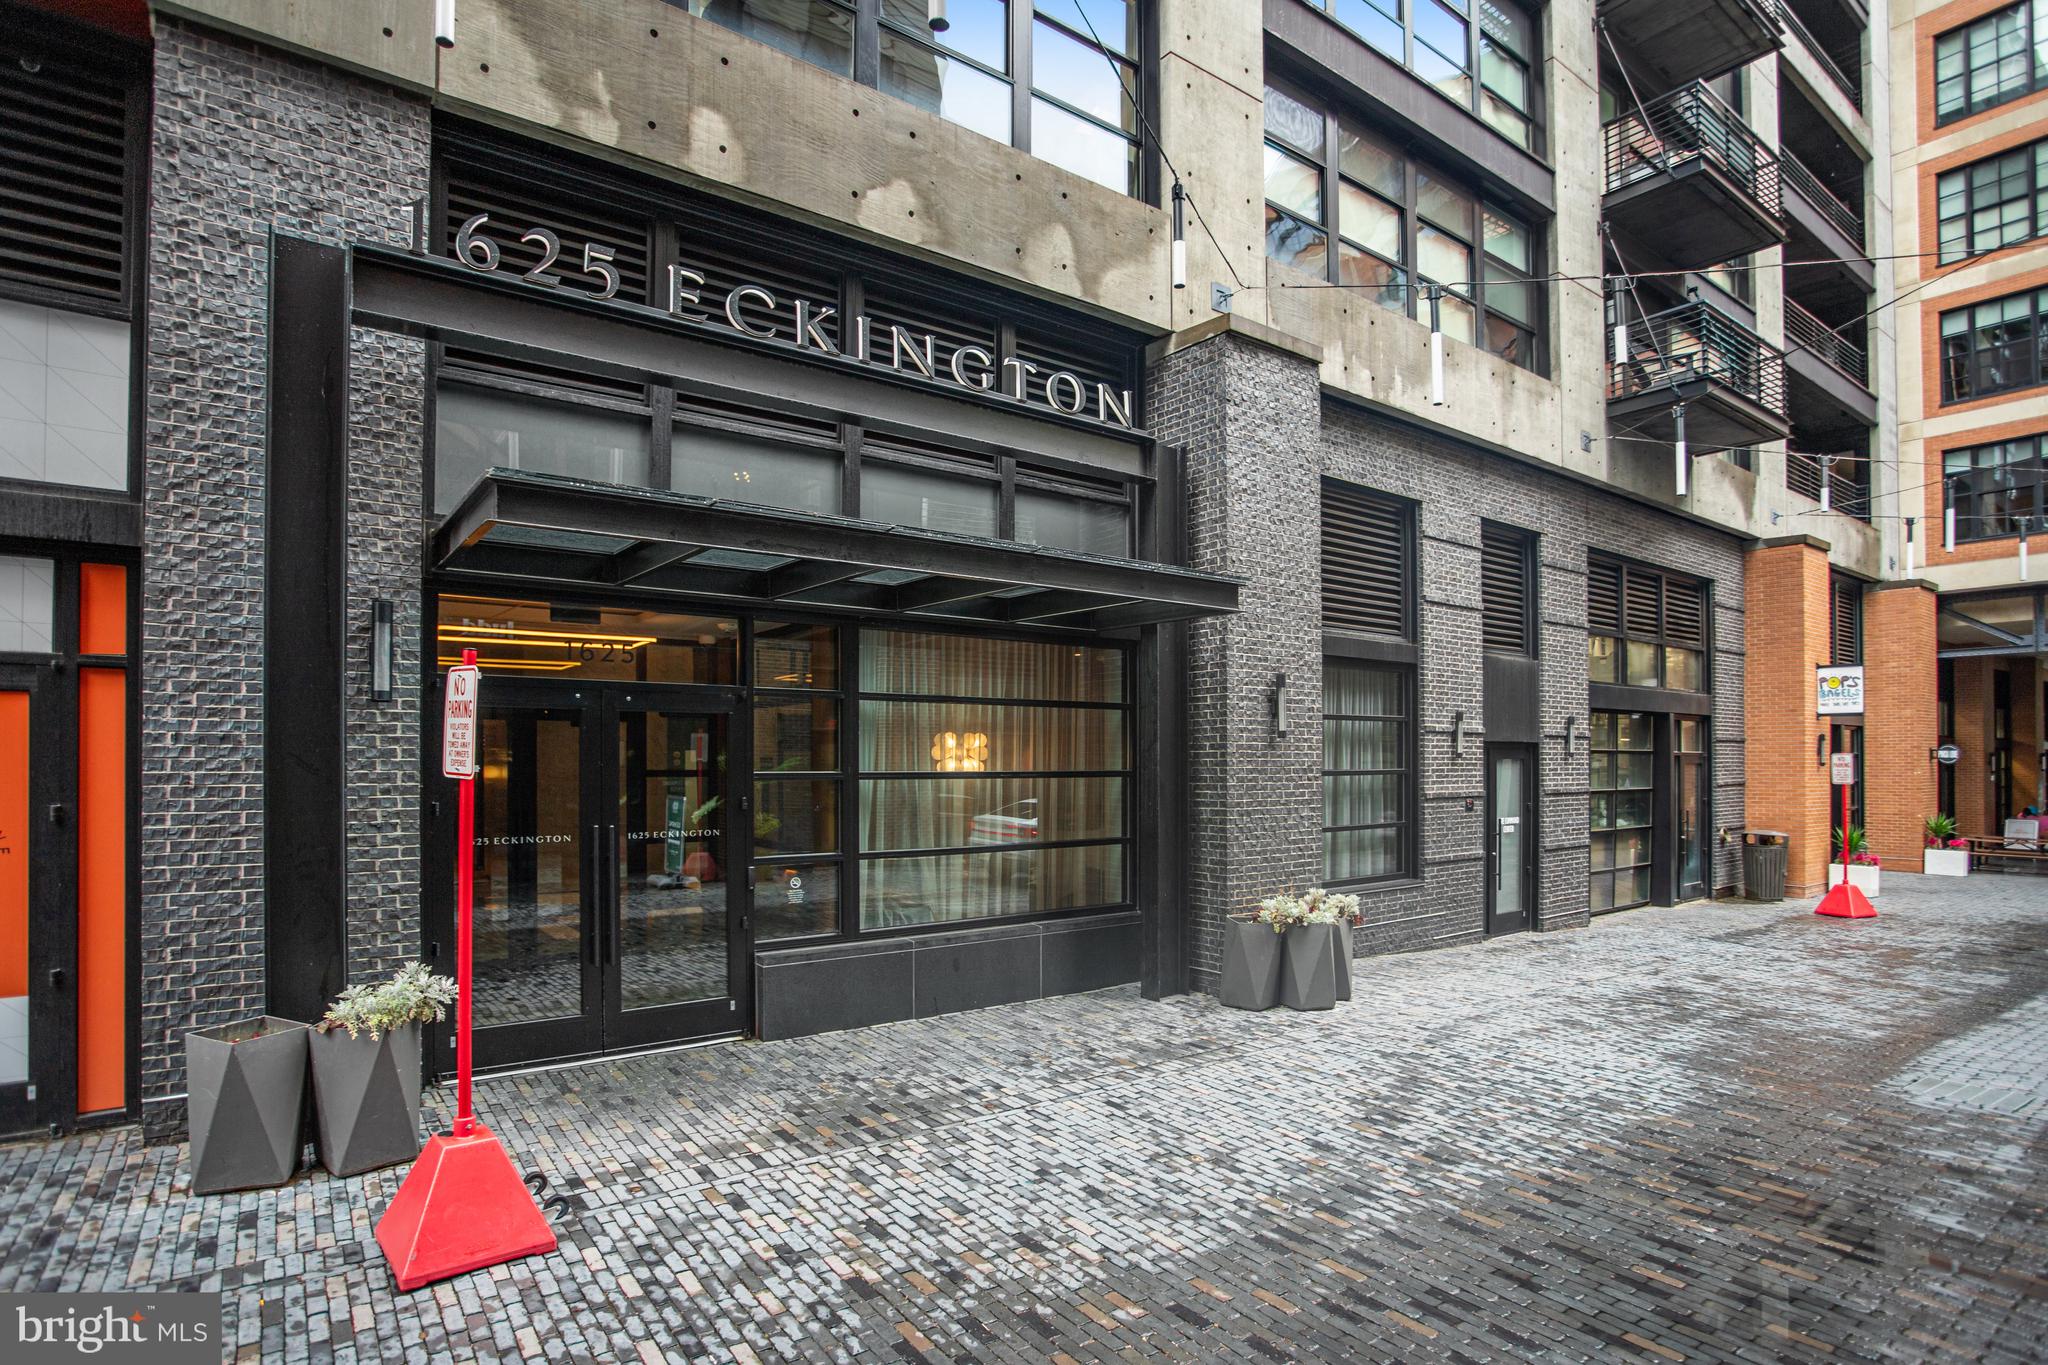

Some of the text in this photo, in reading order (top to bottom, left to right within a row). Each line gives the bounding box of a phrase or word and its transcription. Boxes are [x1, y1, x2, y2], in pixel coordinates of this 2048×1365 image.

[401, 198, 1132, 429] 1625 ECKINGTON
[563, 640, 635, 664] 1625
[454, 677, 467, 696] NO
[1819, 688, 1861, 699] BAGELS
[448, 700, 472, 719] PARKING
[450, 723, 469, 731] VIOLATORS
[460, 732, 466, 740] BE
[448, 741, 471, 749] TOWED AWAY
[451, 759, 467, 767] EXPENSE
[493, 834, 572, 845] ECKINGTON
[627, 829, 721, 840] 1625 ECKINGTON
